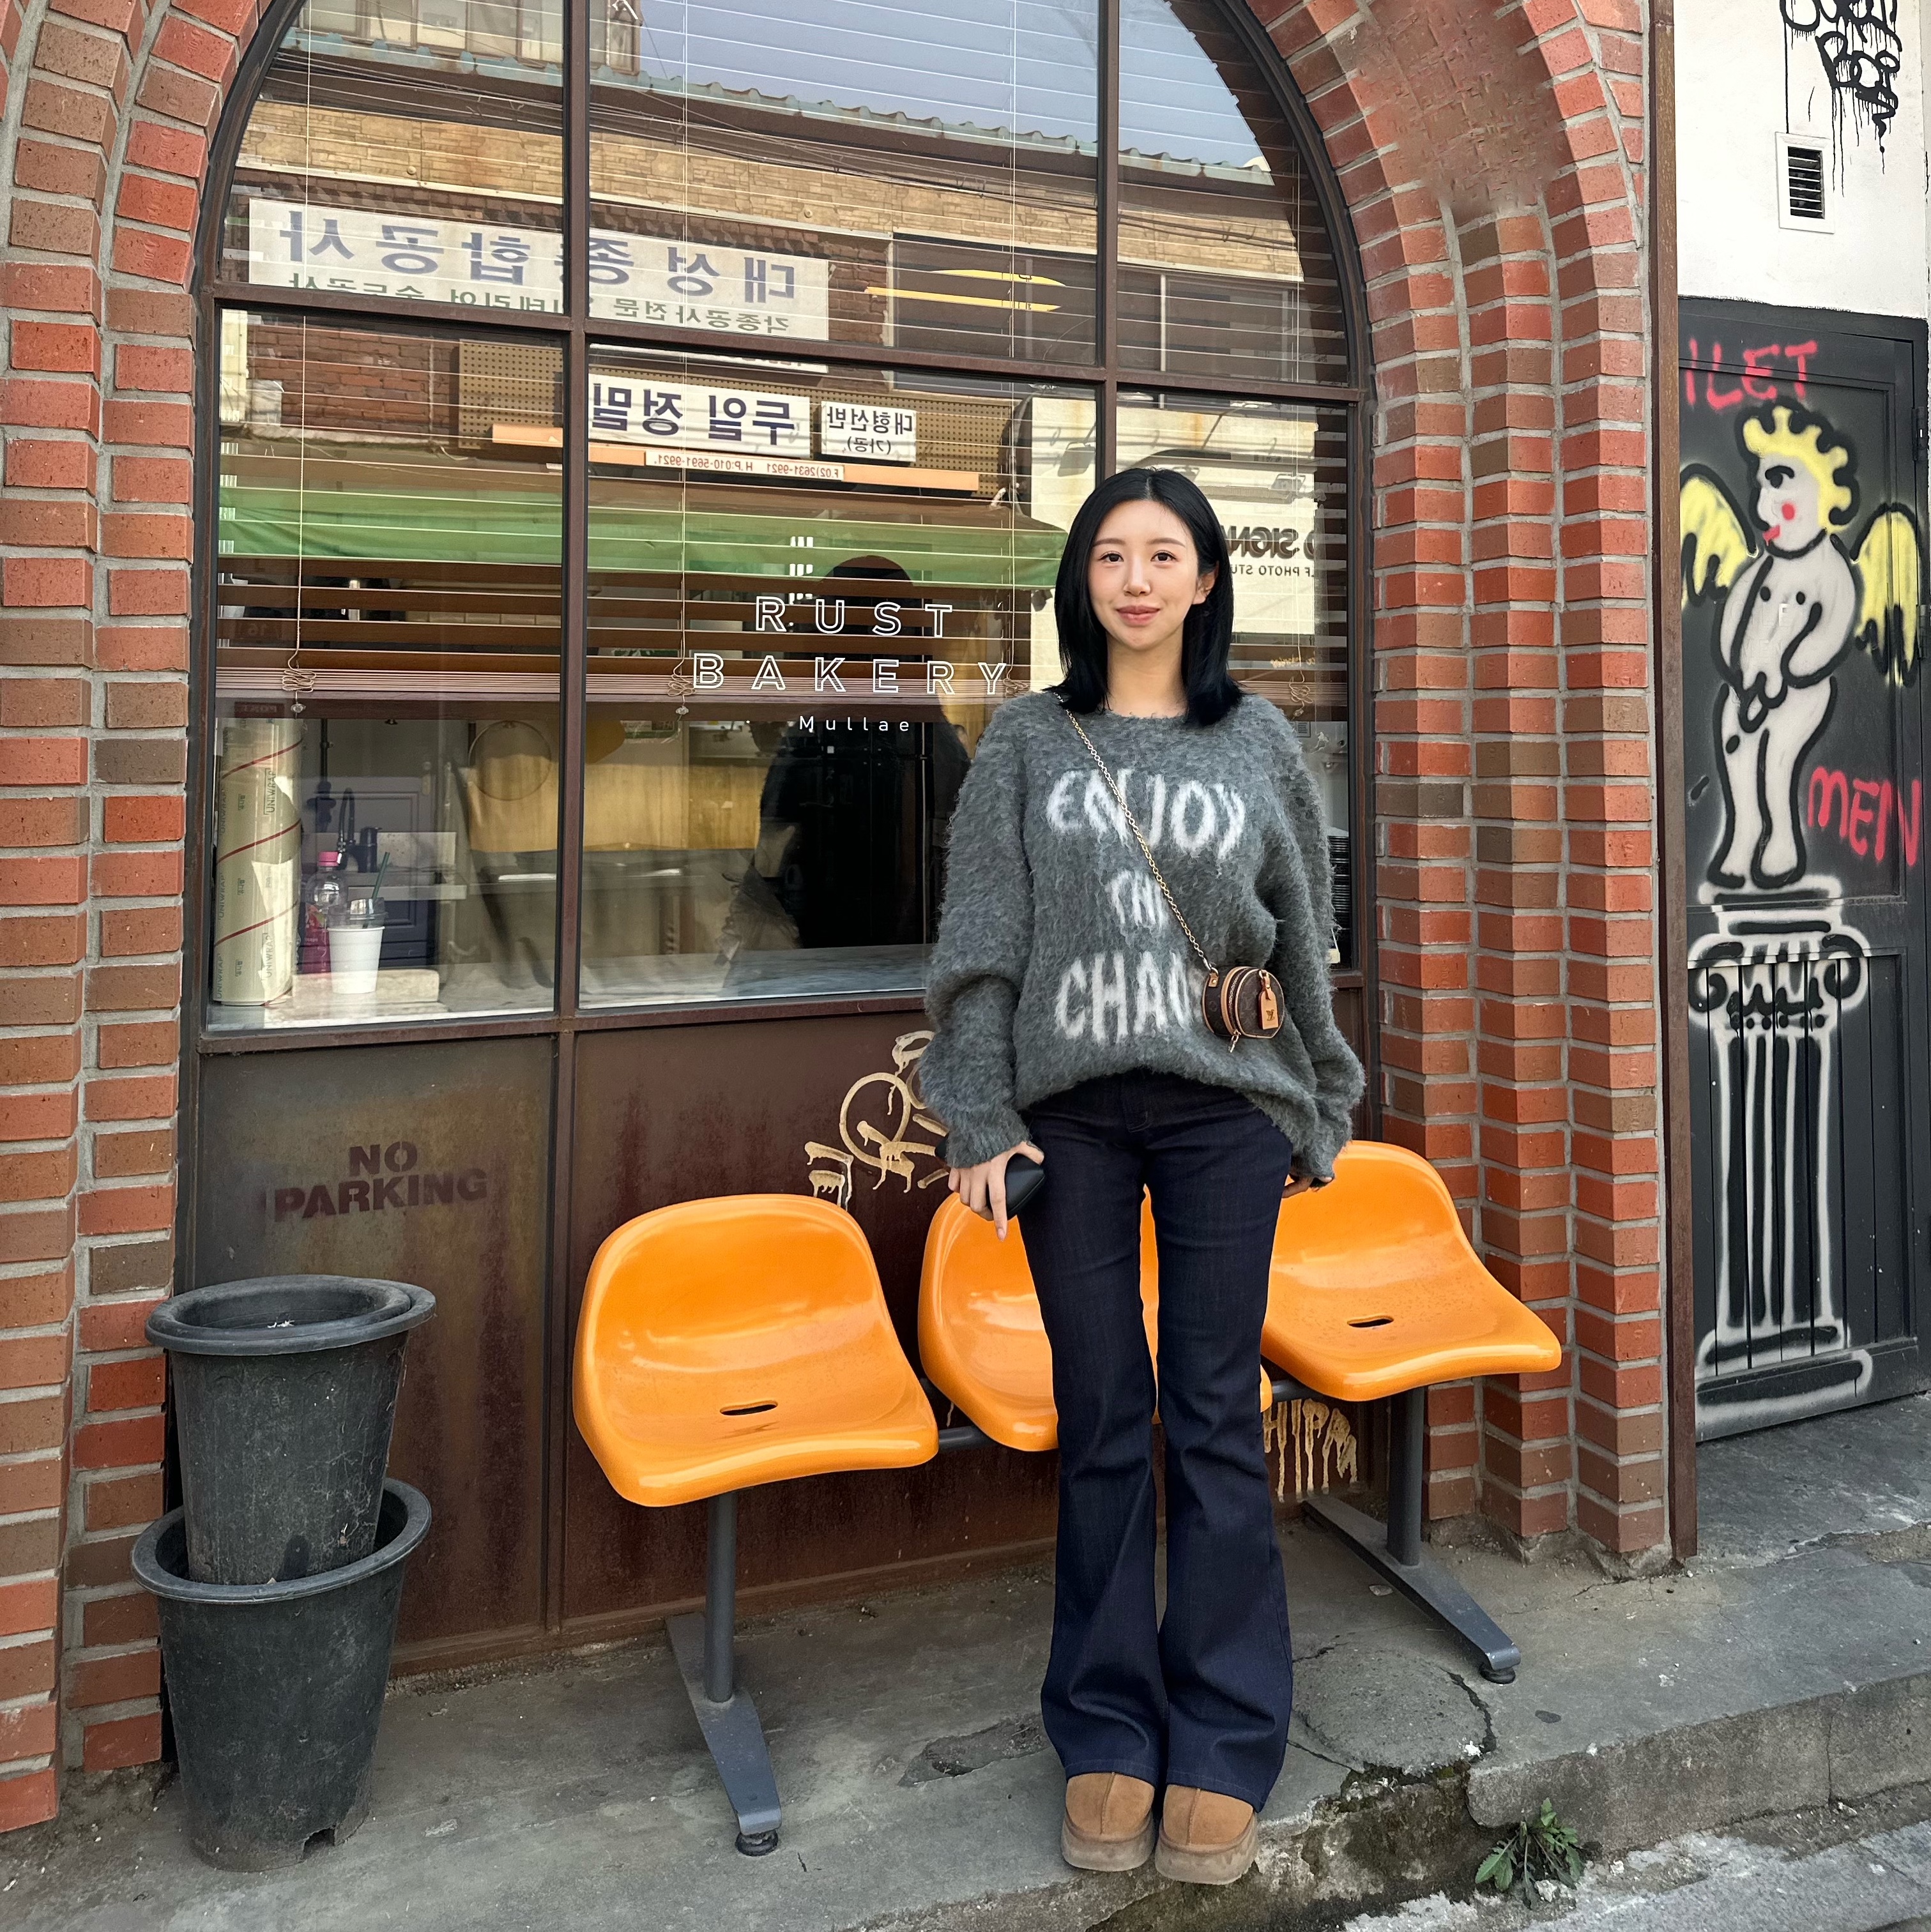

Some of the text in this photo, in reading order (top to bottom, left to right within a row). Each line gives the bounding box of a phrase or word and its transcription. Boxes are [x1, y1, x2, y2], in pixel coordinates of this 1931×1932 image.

[755, 596, 952, 638] RUST
[693, 653, 1007, 695] BAKERY
[799, 715, 910, 733] Mullae
[266, 770, 276, 813] UNIWRAP
[1807, 766, 1921, 867] MEN
[266, 935, 274, 978] UNIWRAP
[349, 1141, 418, 1177] NO
[275, 1168, 487, 1222] PARKING
